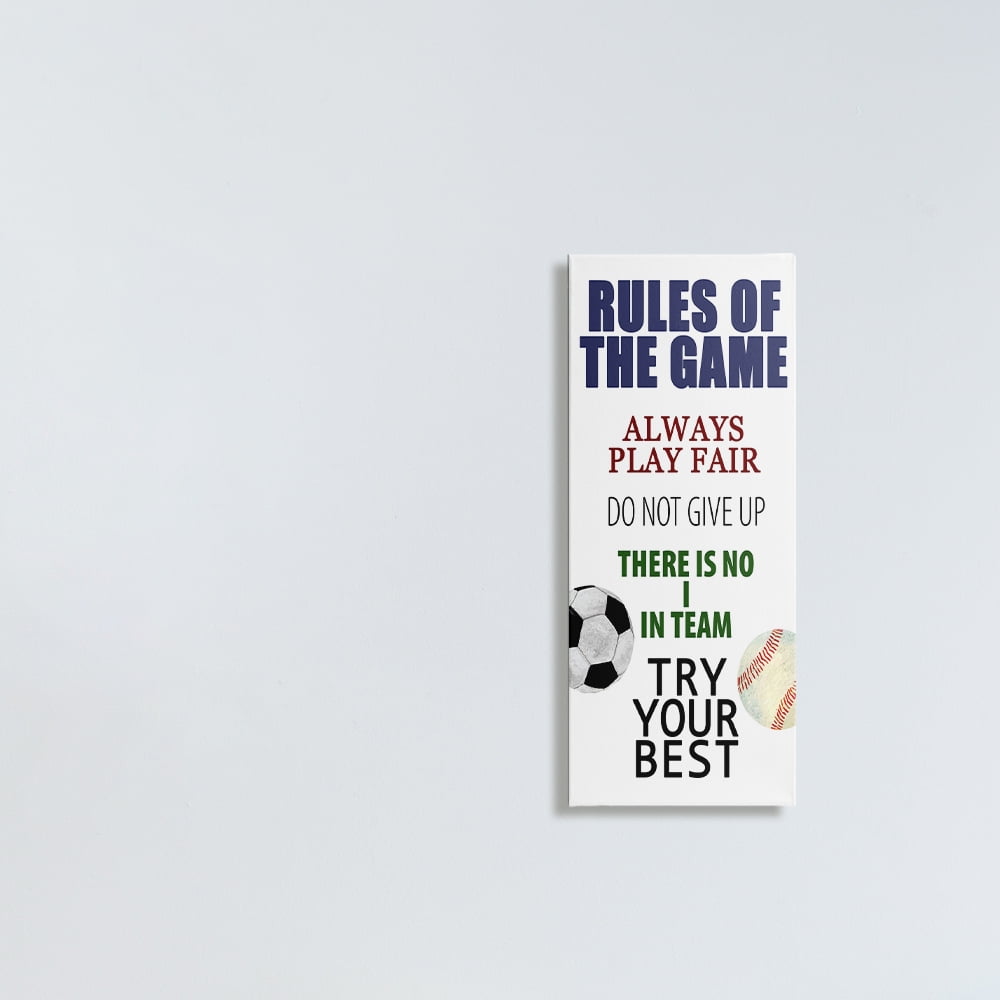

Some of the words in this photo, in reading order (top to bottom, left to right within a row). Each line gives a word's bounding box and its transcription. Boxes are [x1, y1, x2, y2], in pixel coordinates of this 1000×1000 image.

[588, 278, 718, 333] RULES
[730, 278, 782, 333] OF
[579, 335, 658, 389] THE
[670, 334, 788, 389] GAME
[621, 415, 745, 442] ALWAYS
[608, 447, 683, 474] PLAY
[690, 447, 762, 474] FAIR
[607, 496, 636, 527] DO
[642, 496, 682, 527] NOT
[687, 496, 733, 527] GIVE
[739, 496, 766, 527] UP
[617, 550, 690, 578] THERE
[696, 550, 717, 578] IS
[722, 550, 755, 578] NO
[683, 580, 690, 608] I
[640, 611, 665, 639] IN
[670, 611, 733, 639] TEAM
[647, 657, 727, 696] TRY
[632, 698, 739, 738] YOUR
[635, 739, 739, 779] BEST
